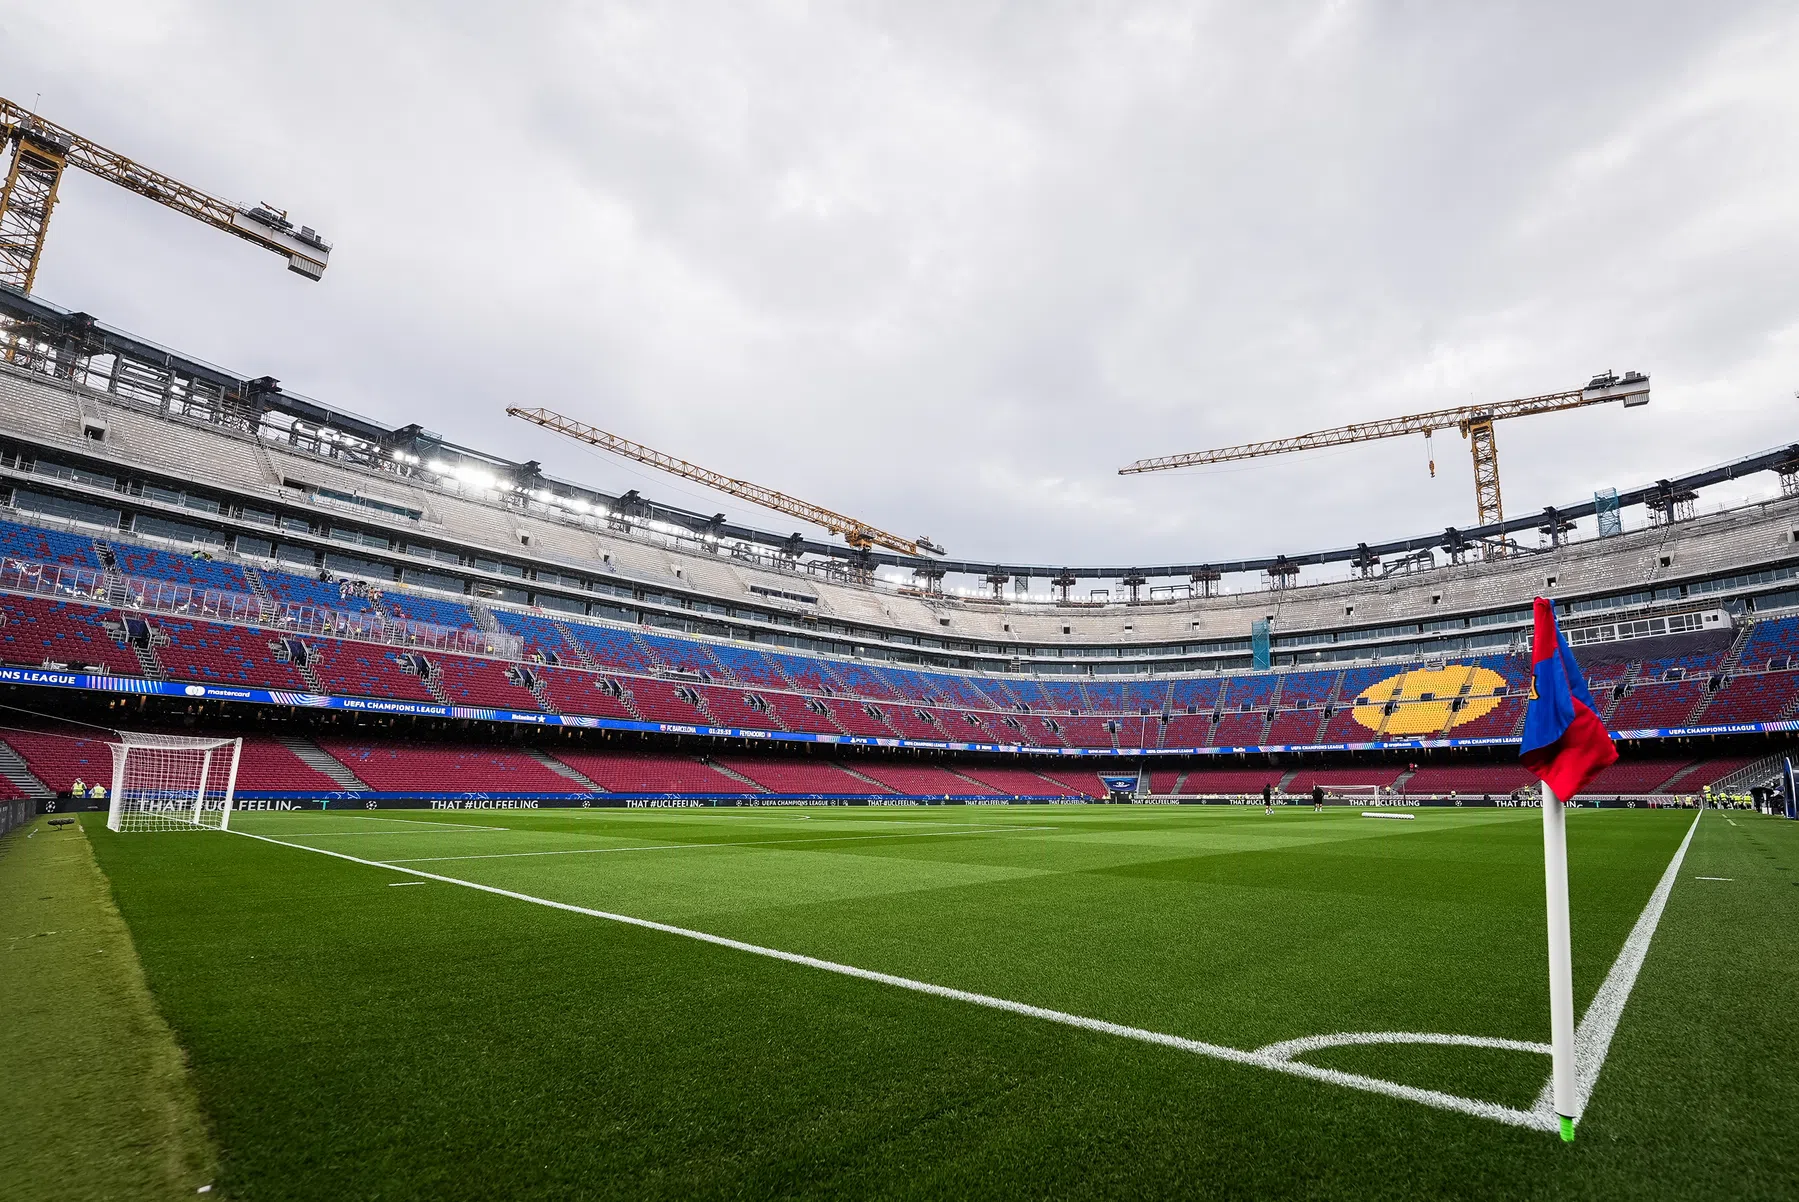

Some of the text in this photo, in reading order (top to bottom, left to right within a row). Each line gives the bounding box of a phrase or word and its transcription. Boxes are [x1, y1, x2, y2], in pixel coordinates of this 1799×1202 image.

[0, 670, 76, 684] NS LEAGUE
[207, 689, 251, 698] mastercard
[343, 700, 446, 715] UEFA CHAMPIONS LEAGUE
[673, 725, 697, 734] BARCELONA
[739, 730, 766, 738] FEYENOORD
[1686, 726, 1727, 734] CHAMPIONS
[138, 800, 187, 812] THAT
[430, 800, 539, 810] THAT #UCLFEELING
[626, 799, 649, 808] THAT
[1494, 800, 1518, 808] THAT
